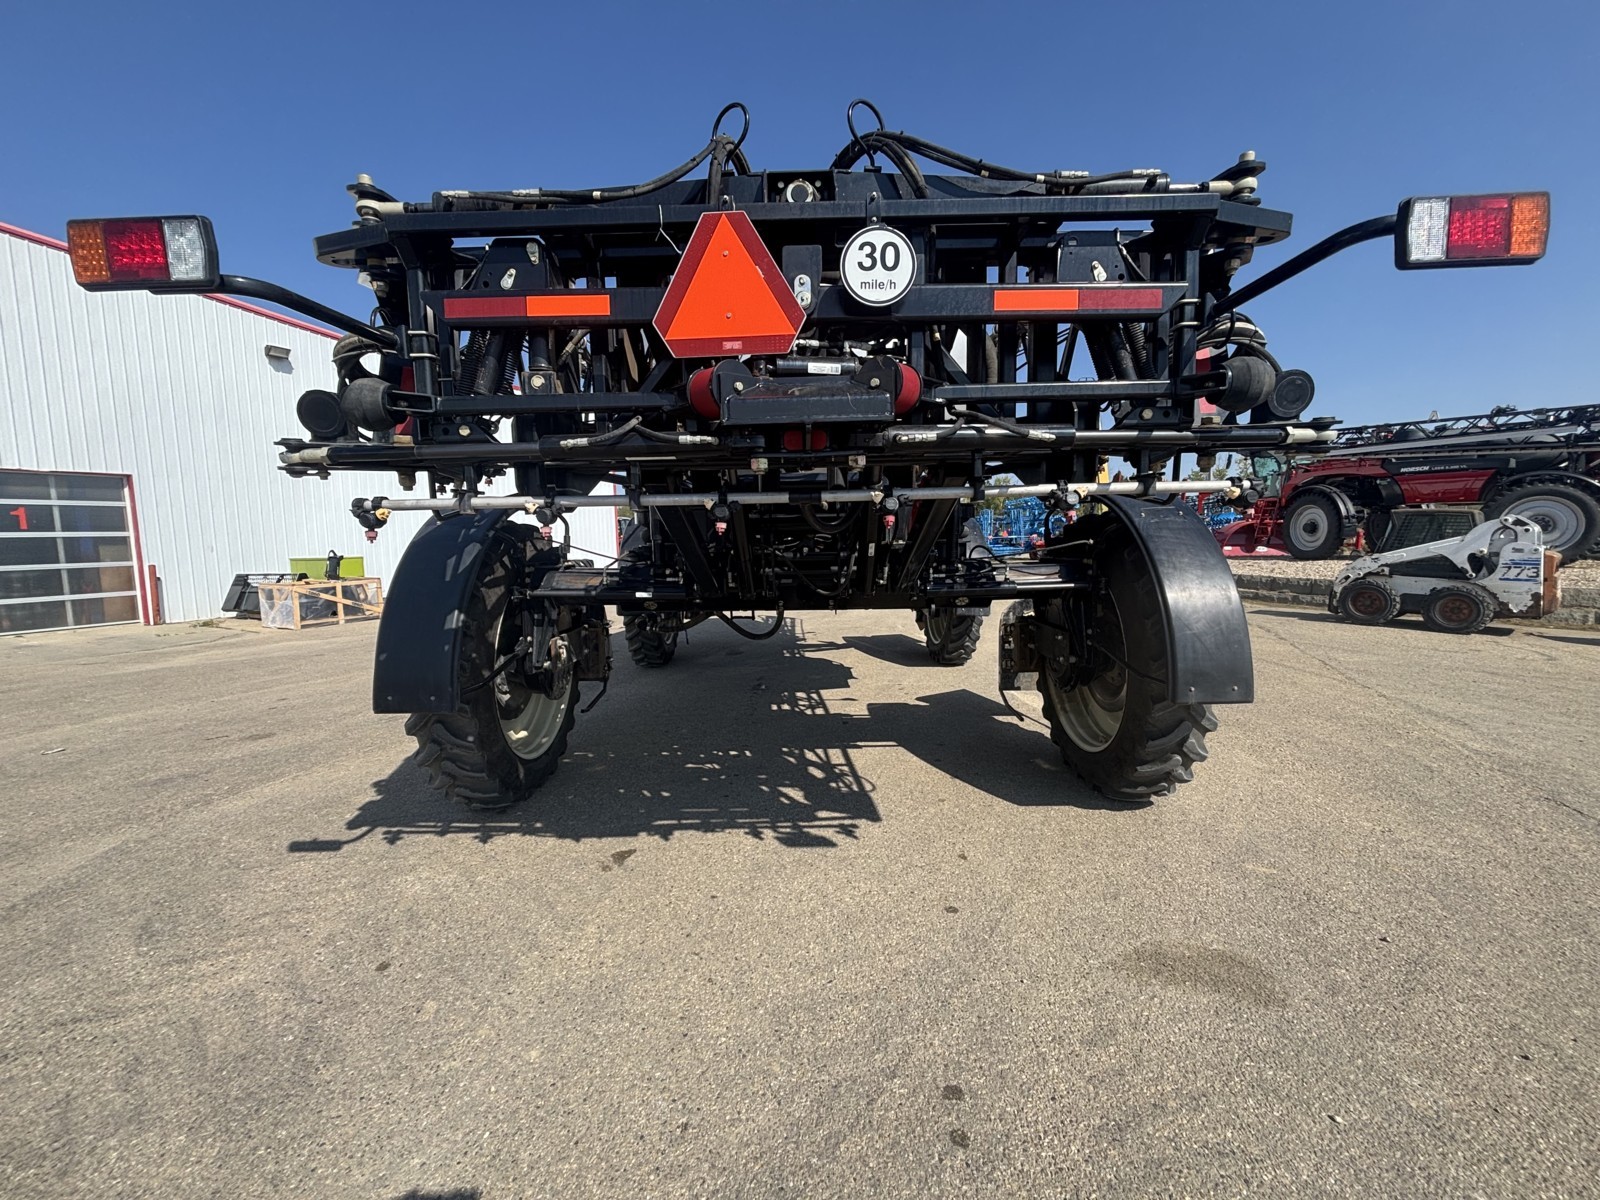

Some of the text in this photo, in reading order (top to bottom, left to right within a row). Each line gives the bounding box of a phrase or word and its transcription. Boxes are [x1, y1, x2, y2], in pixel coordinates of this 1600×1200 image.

[857, 241, 900, 272] 30
[860, 279, 897, 291] mile/h
[9, 506, 28, 530] 1
[1500, 565, 1540, 578] 773
